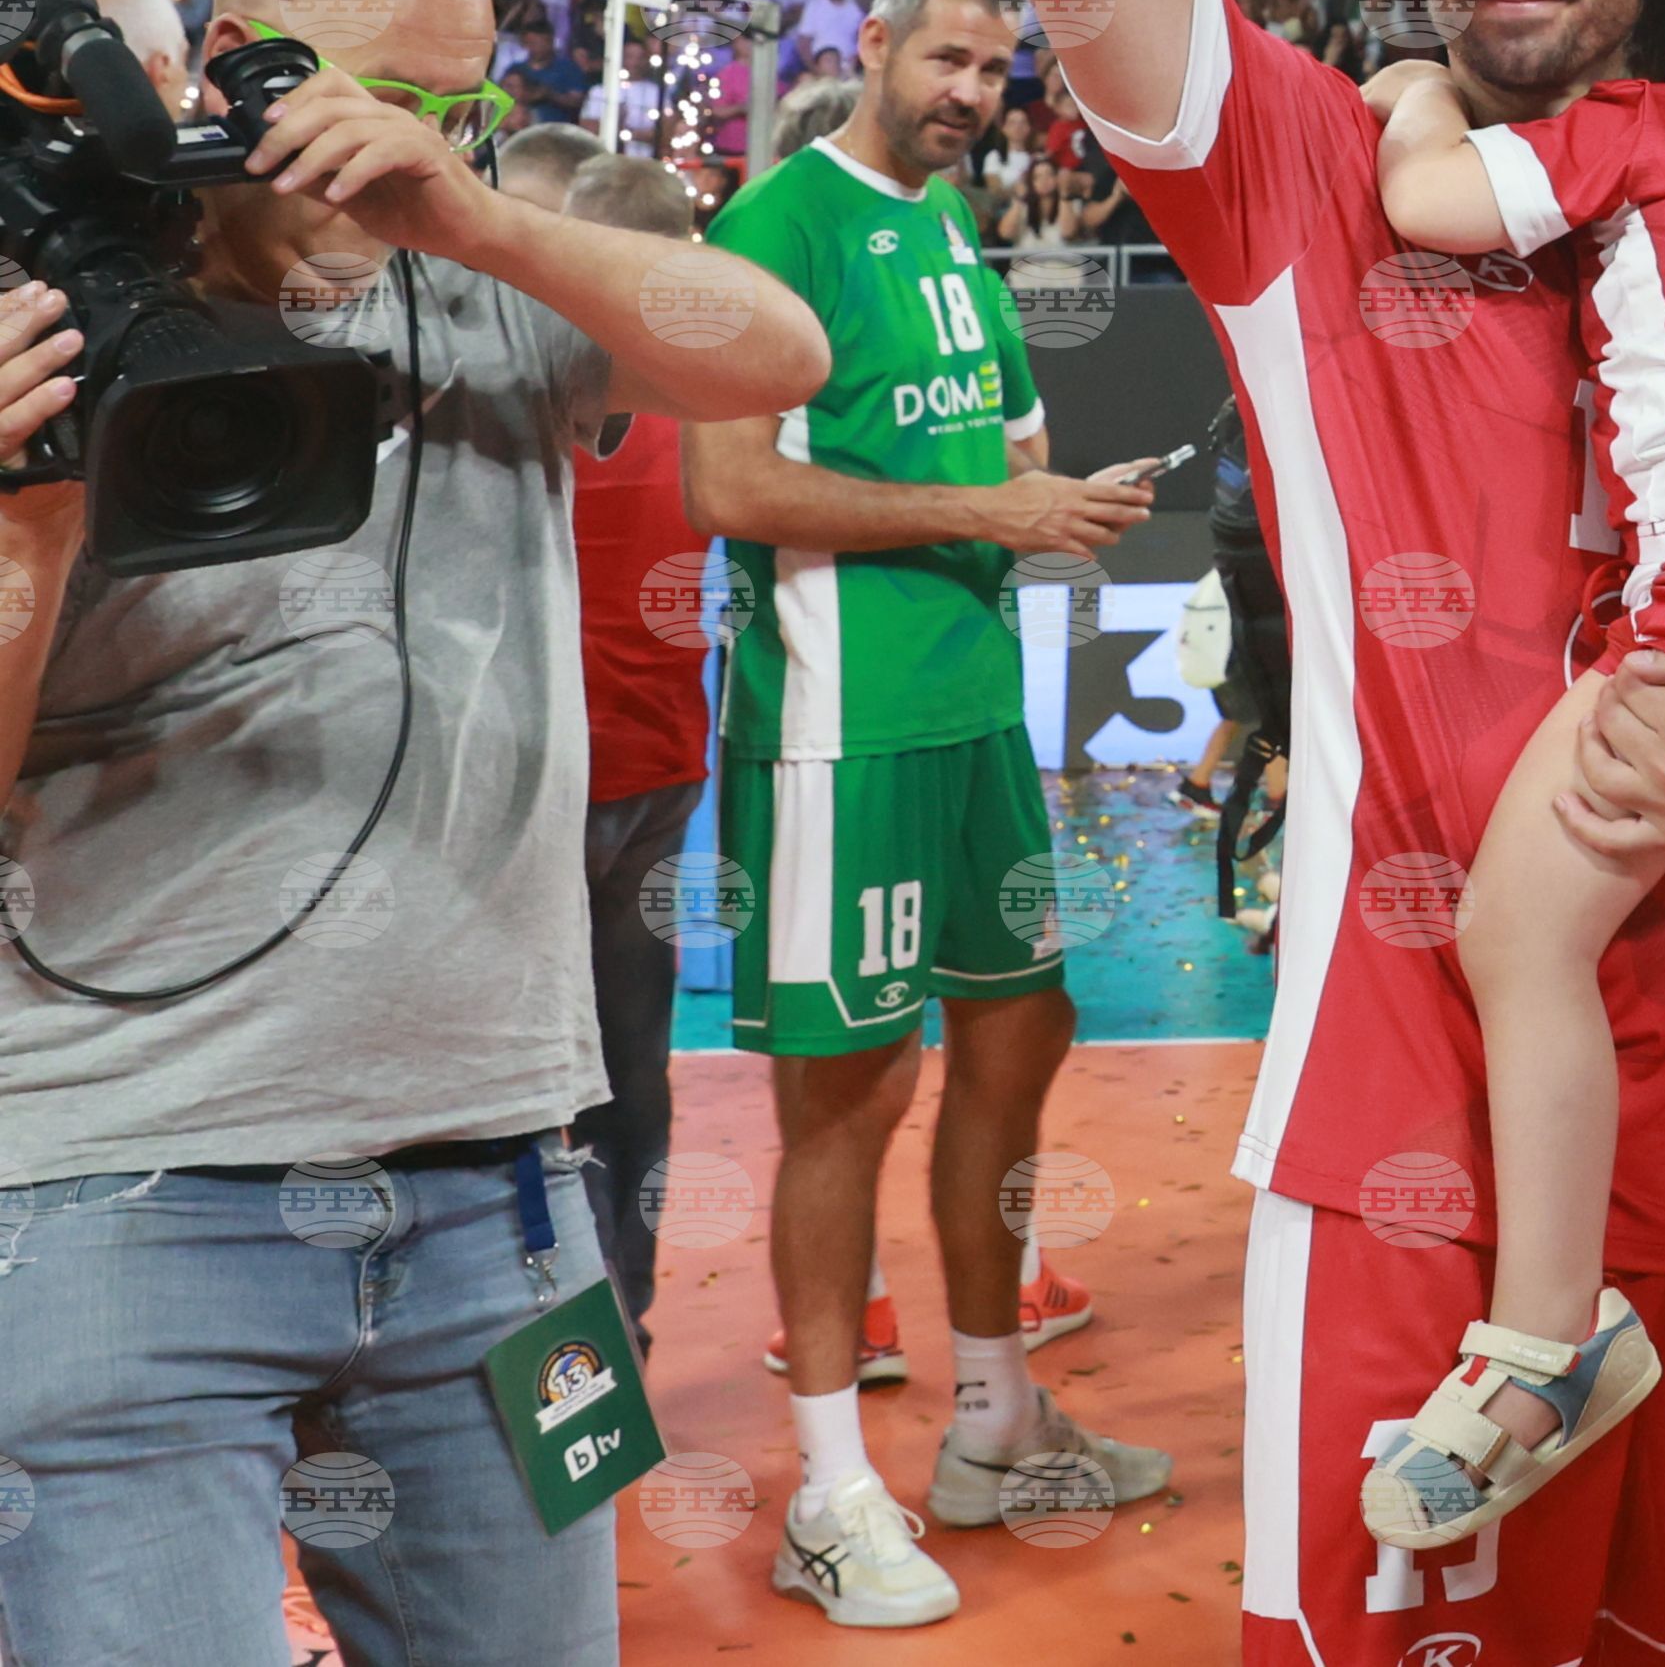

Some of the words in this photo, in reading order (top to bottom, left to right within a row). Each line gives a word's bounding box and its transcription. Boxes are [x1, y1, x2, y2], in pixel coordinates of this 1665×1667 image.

[919, 271, 985, 356] 18
[858, 881, 923, 977] 18
[554, 1363, 588, 1399] 13
